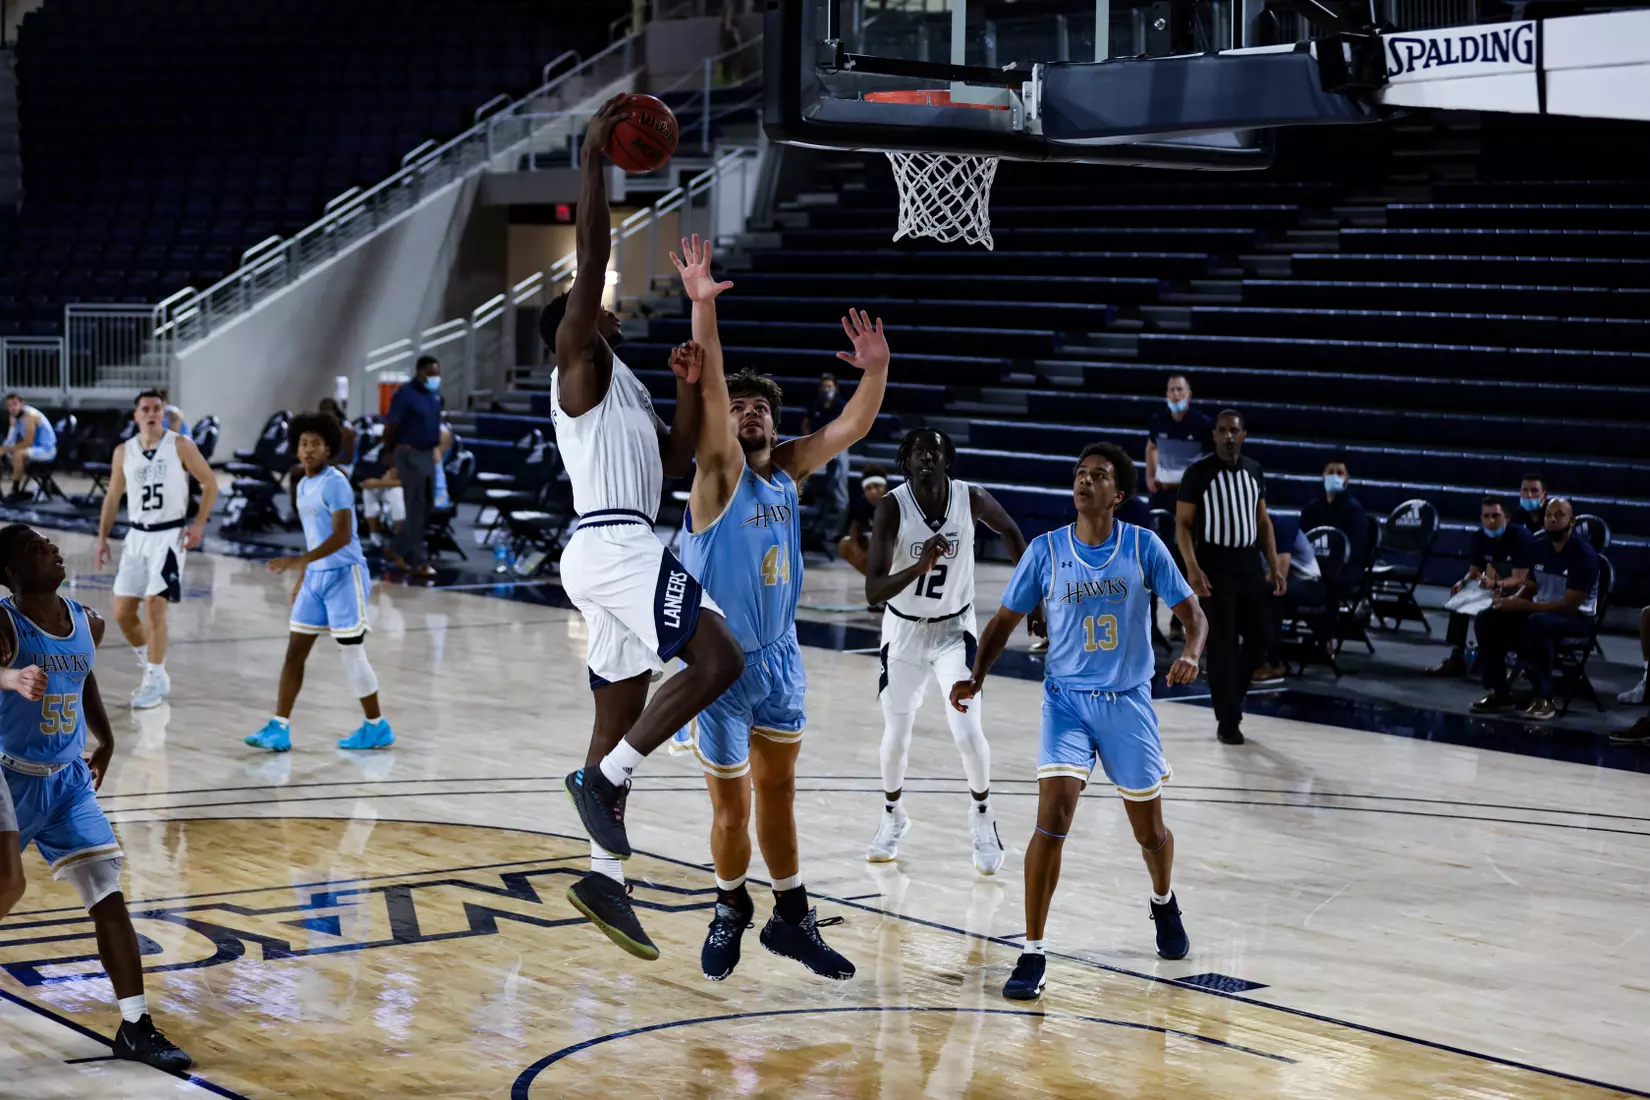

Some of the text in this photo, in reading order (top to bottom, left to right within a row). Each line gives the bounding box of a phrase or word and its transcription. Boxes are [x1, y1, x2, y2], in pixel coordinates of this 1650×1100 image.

[1388, 22, 1534, 78] SPALDING
[142, 482, 163, 511] 25
[760, 541, 791, 586] 44
[909, 539, 960, 560] CU
[663, 570, 688, 629] LANCERS
[914, 564, 948, 600] 12
[1057, 577, 1128, 604] HAWKS
[1083, 614, 1119, 652] 13
[31, 653, 90, 680] HAWKS
[39, 693, 79, 736] 55
